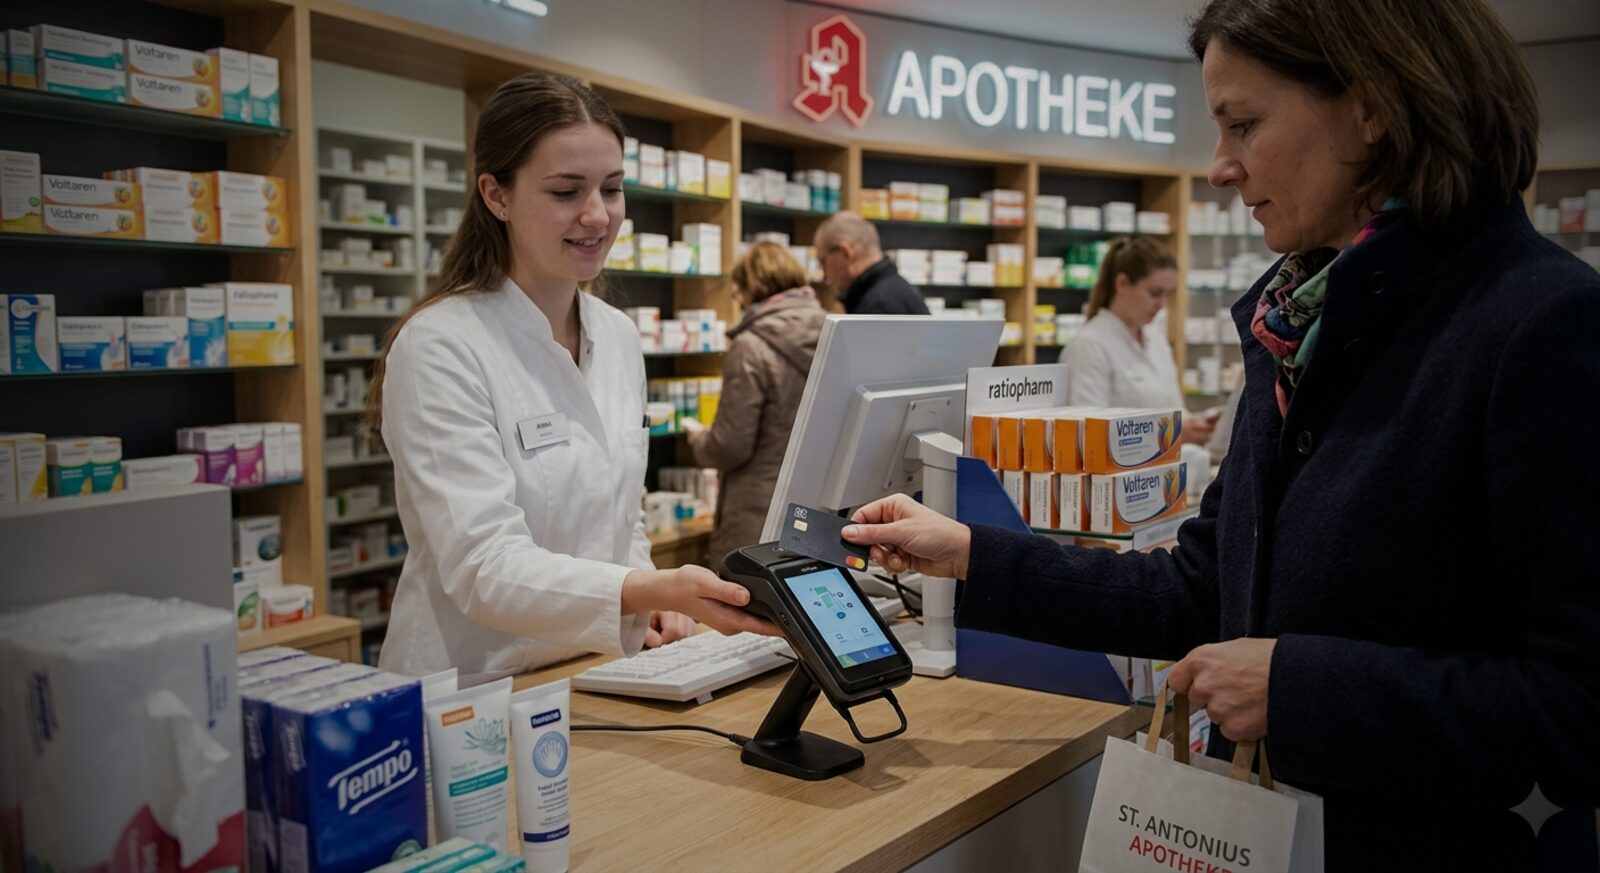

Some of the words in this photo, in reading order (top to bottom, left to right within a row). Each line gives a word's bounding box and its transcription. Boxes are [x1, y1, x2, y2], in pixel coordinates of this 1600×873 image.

[887, 50, 1177, 144] APOTHEKE
[48, 178, 97, 193] Voltaren
[988, 377, 1053, 402] ratiopharm
[1123, 475, 1160, 494] Voltaren
[327, 741, 416, 814] Tempo
[1118, 804, 1140, 828] ST.
[1145, 815, 1251, 867] ANTONIUS
[1128, 835, 1233, 873] APOTHEK
